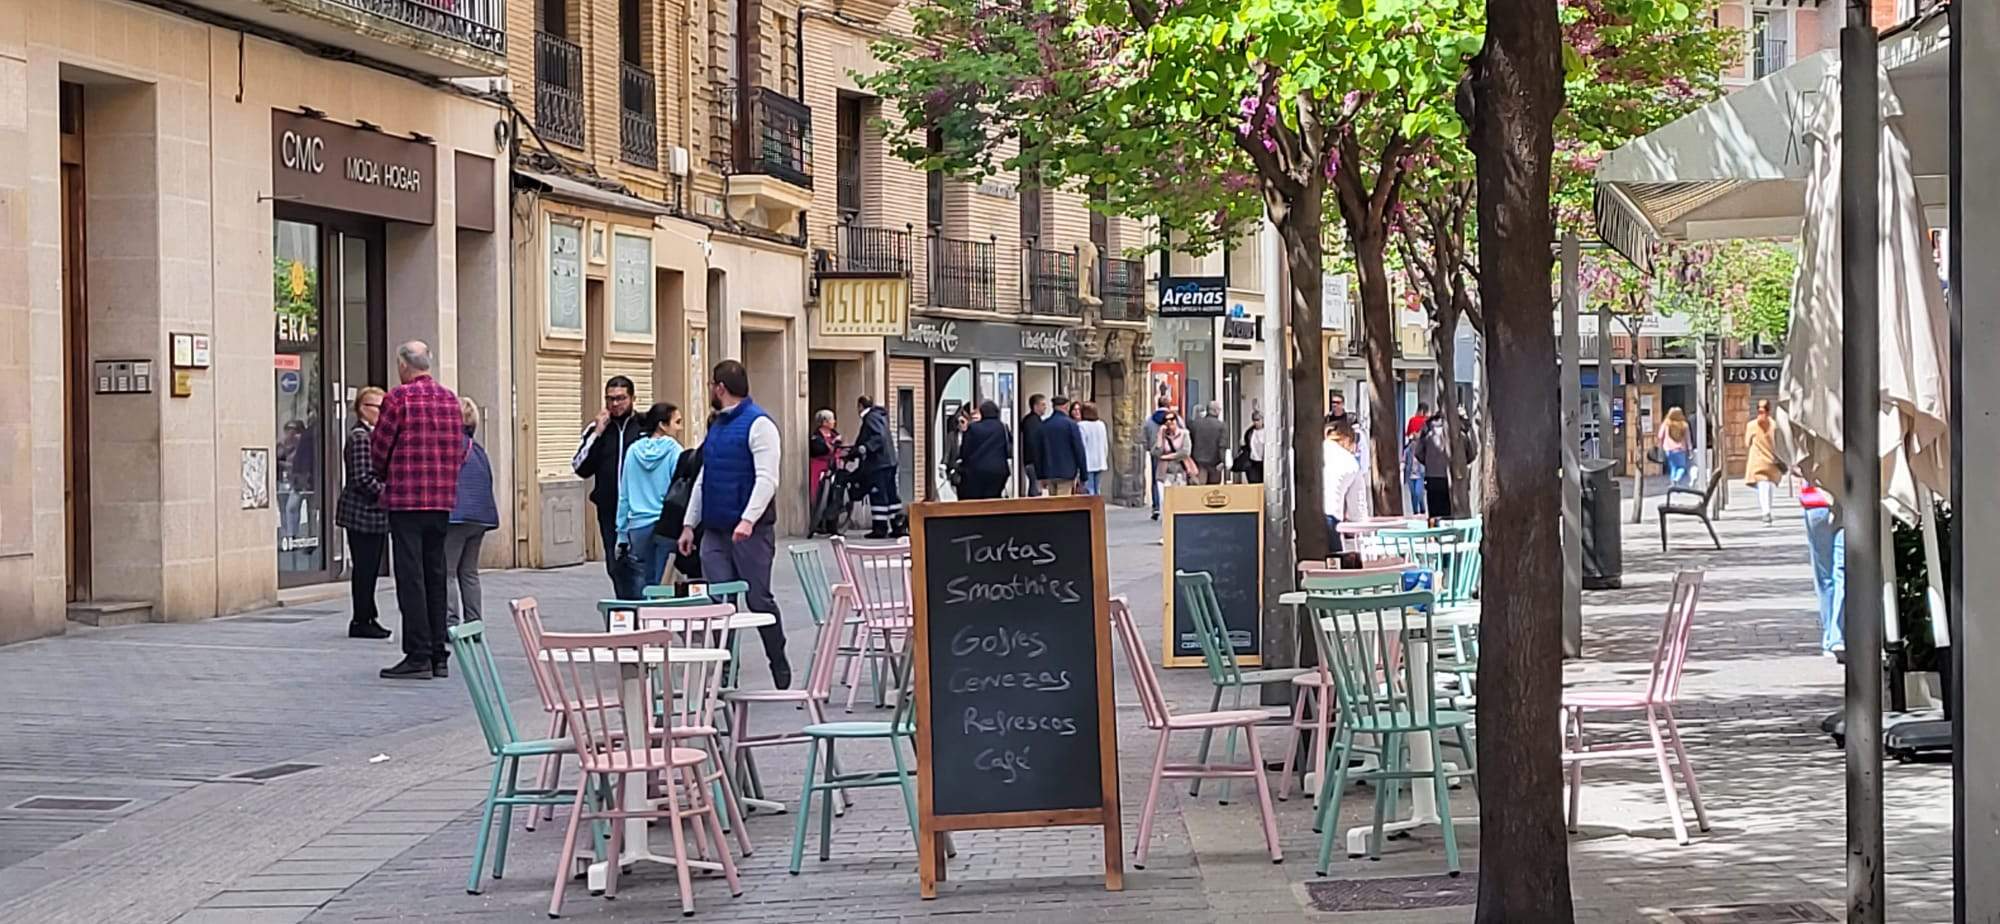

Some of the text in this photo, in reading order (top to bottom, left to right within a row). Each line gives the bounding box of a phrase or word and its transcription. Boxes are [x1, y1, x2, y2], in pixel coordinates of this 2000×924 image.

[281, 130, 325, 174] CMC
[346, 156, 421, 193] MODA HOGAR
[825, 281, 899, 324] ASCASO
[1161, 288, 1224, 306] Arenas
[1728, 367, 1779, 382] FOSKO
[951, 534, 1057, 565] Tartas
[944, 573, 1081, 604] Smoothies
[950, 624, 1048, 658] Gofres
[949, 668, 1072, 693] Cervezas
[963, 706, 1078, 736] Refrescos
[974, 746, 1032, 784] Café
